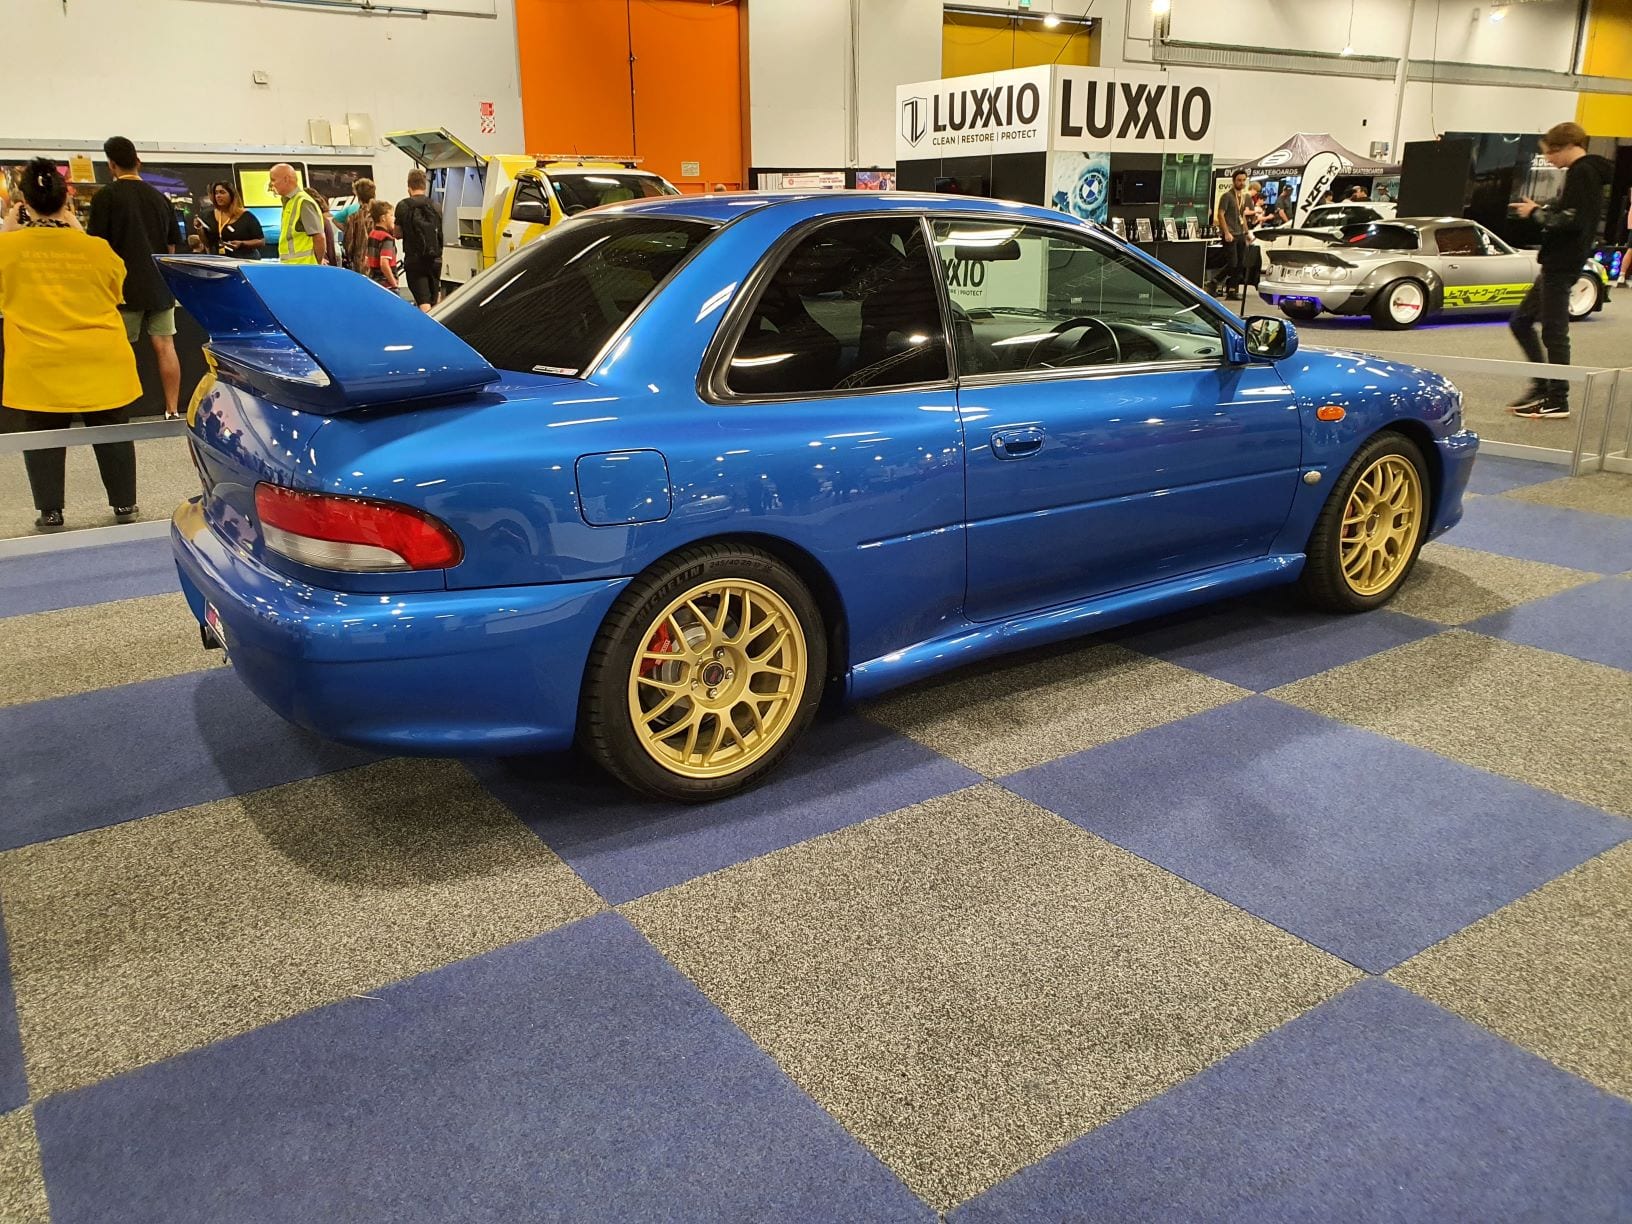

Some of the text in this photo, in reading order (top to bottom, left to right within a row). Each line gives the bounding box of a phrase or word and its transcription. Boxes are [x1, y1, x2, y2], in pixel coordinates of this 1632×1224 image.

[933, 82, 1040, 132] LUXXIO
[1060, 79, 1211, 141] LUXXIO
[932, 129, 1037, 146] CLEAN RESTORE PROTECT
[1252, 168, 1299, 176] SKATEBOARDS
[1300, 175, 1330, 213] NZFC
[941, 259, 985, 288] XXIO
